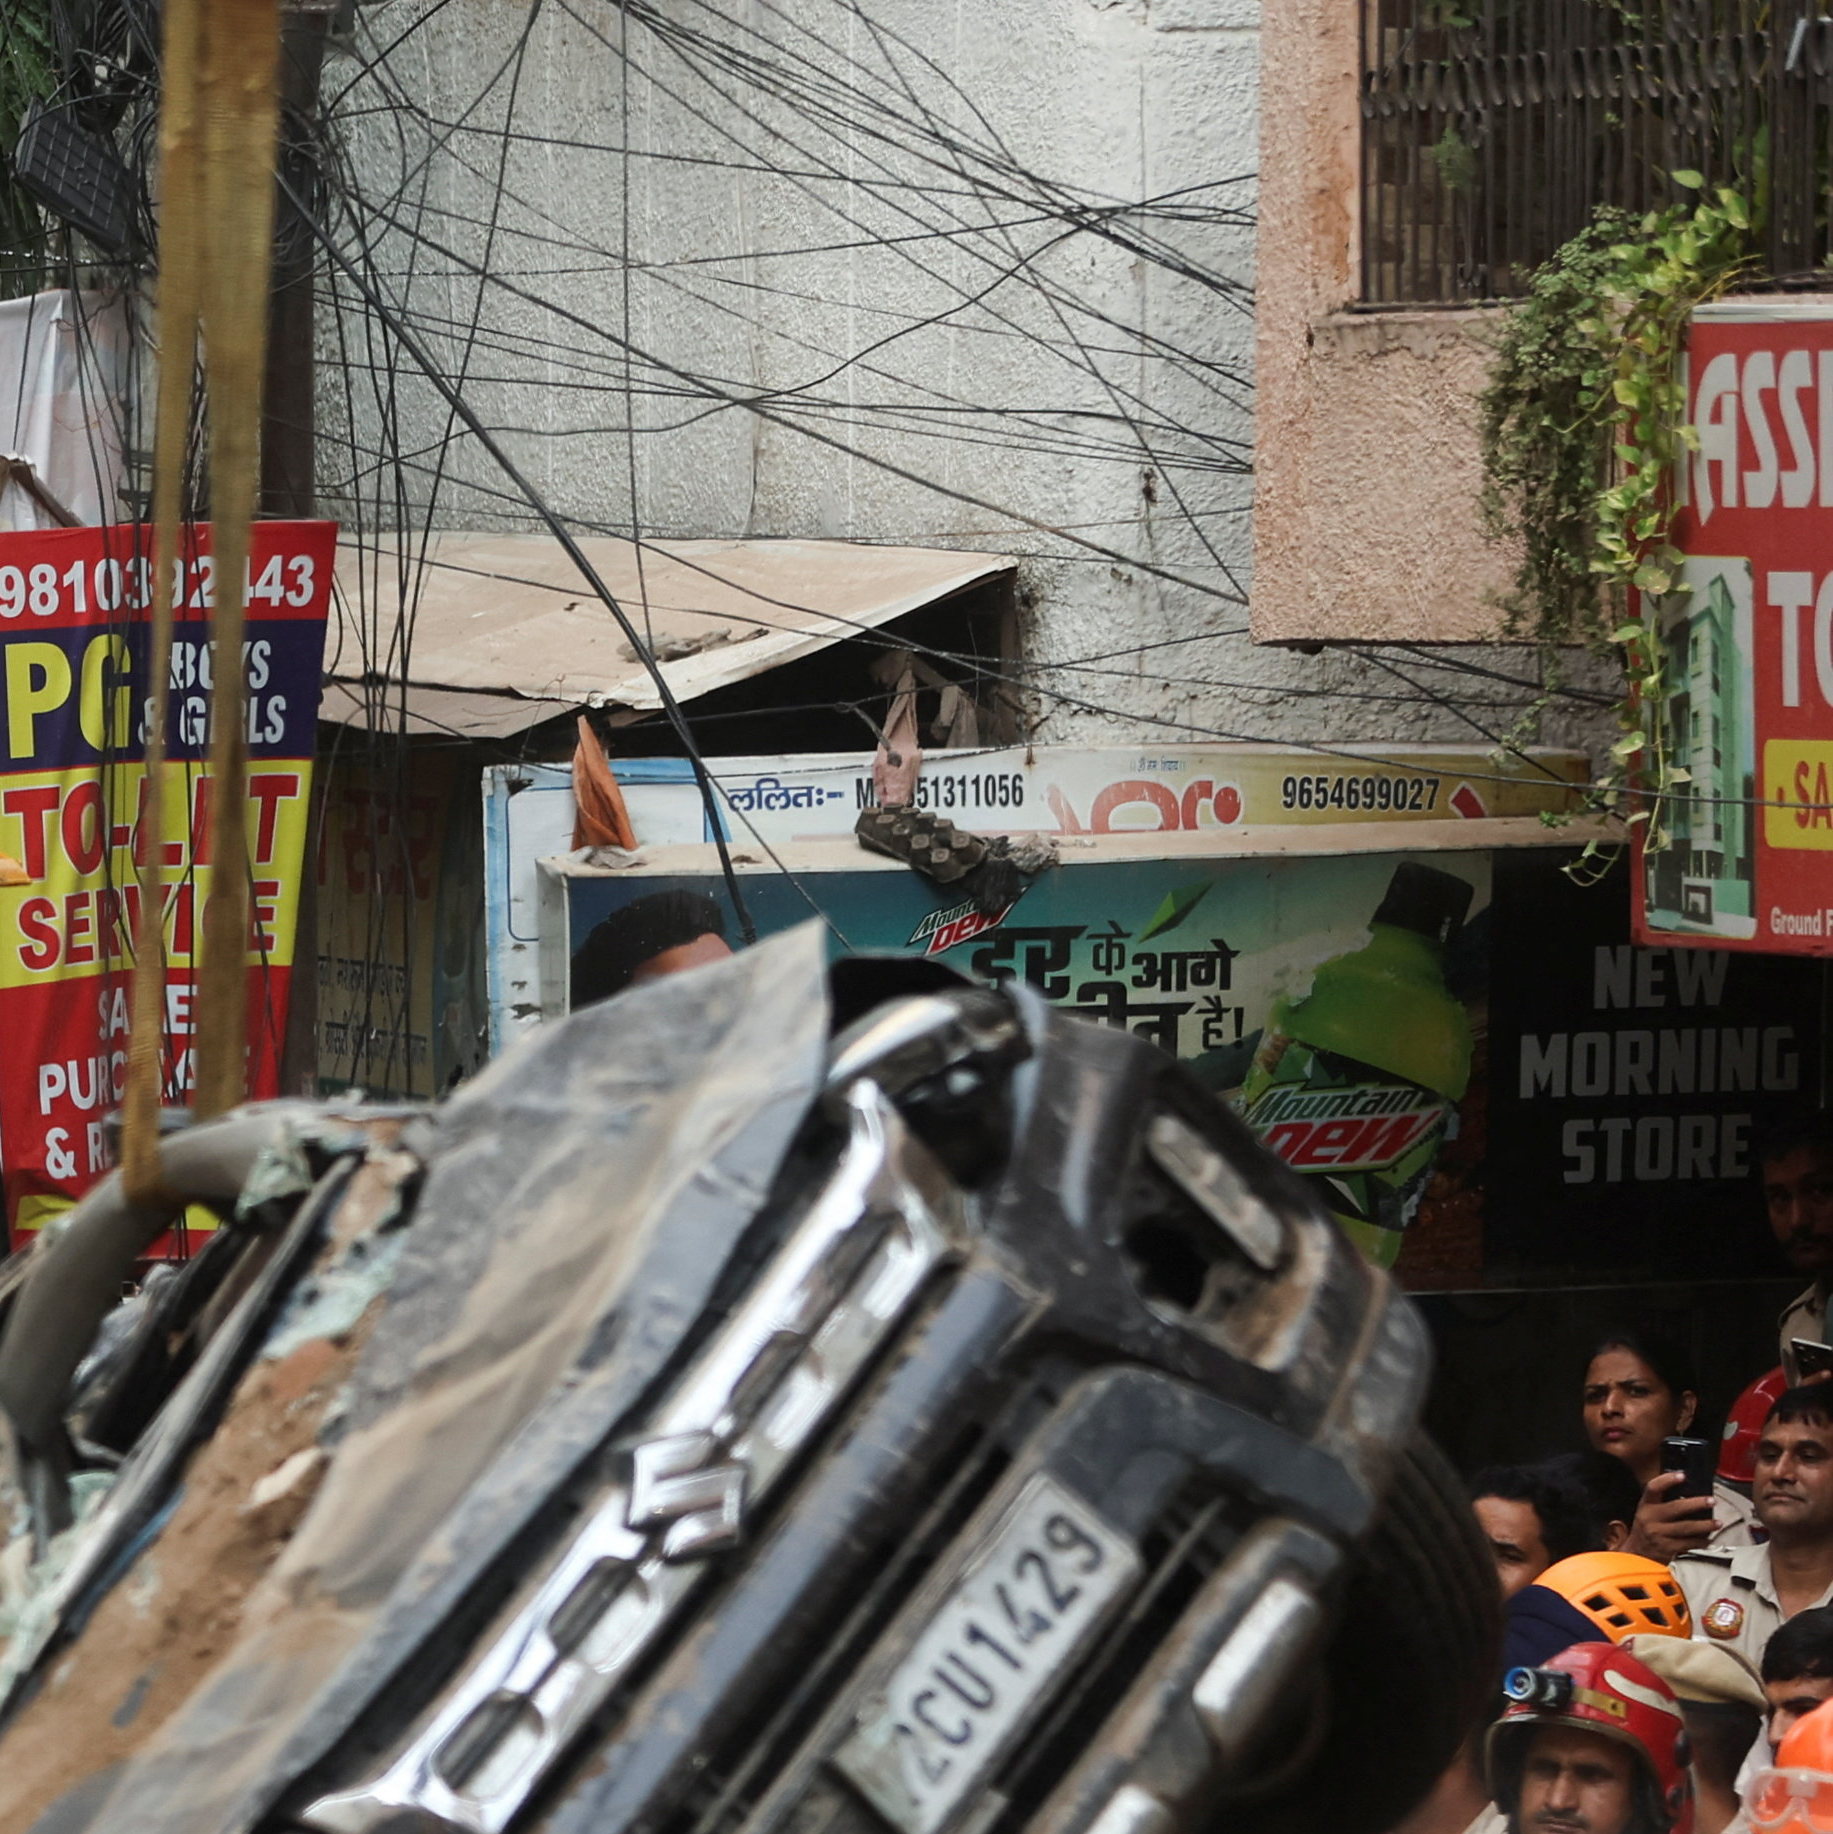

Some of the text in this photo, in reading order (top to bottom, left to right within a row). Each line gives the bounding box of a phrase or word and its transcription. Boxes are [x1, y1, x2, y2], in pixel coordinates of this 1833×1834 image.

[5, 633, 131, 760] PG
[1282, 774, 1440, 812] 9654699027
[1769, 905, 1822, 937] Ground
[1086, 920, 1133, 977] के
[1131, 938, 1241, 993] आगे
[1593, 944, 1731, 1010] NEW
[98, 984, 198, 1041] SAE
[1520, 1026, 1799, 1098] MORNING
[1247, 1088, 1417, 1126] Mountain
[45, 1127, 77, 1180] &
[1562, 1113, 1753, 1184] STORE
